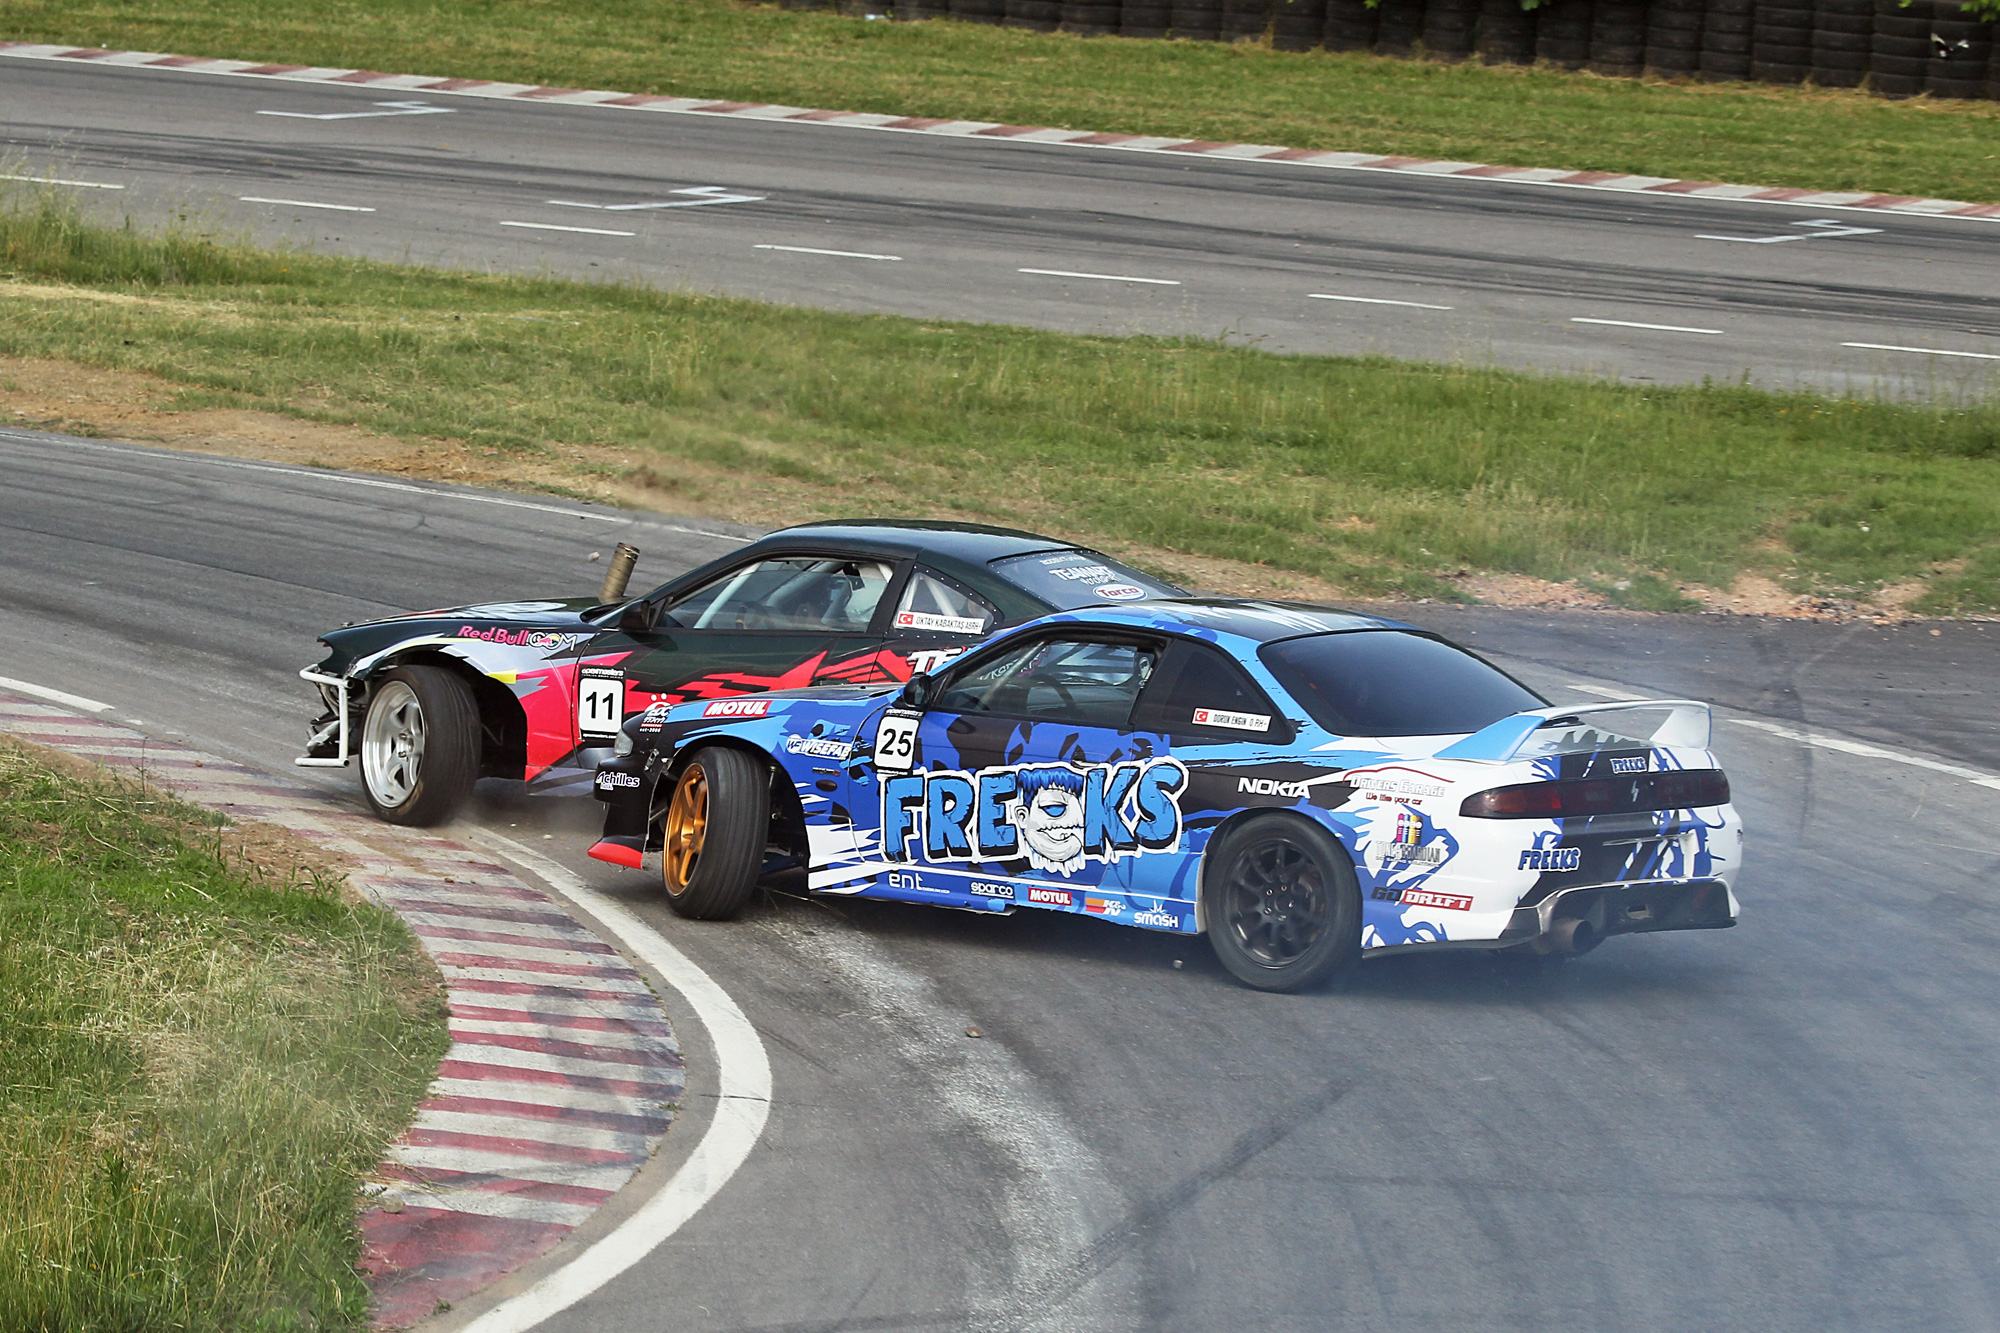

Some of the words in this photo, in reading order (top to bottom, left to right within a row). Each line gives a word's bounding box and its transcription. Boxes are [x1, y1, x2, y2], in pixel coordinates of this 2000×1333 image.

[586, 691, 614, 720] 11
[705, 701, 768, 715] MOTUL
[802, 741, 851, 758] WISEFAB
[879, 728, 913, 757] 25
[1610, 757, 1647, 774] FREEKS
[596, 771, 640, 787] Achilles
[1350, 775, 1398, 793] DRIVERS
[1400, 779, 1446, 798] GARAGE
[1366, 792, 1378, 801] We
[1394, 796, 1411, 804] your
[1518, 848, 1581, 872] FREEKS
[970, 881, 1014, 897] sparco
[1030, 889, 1070, 904] MOTUL
[1405, 891, 1472, 909] DRIFT
